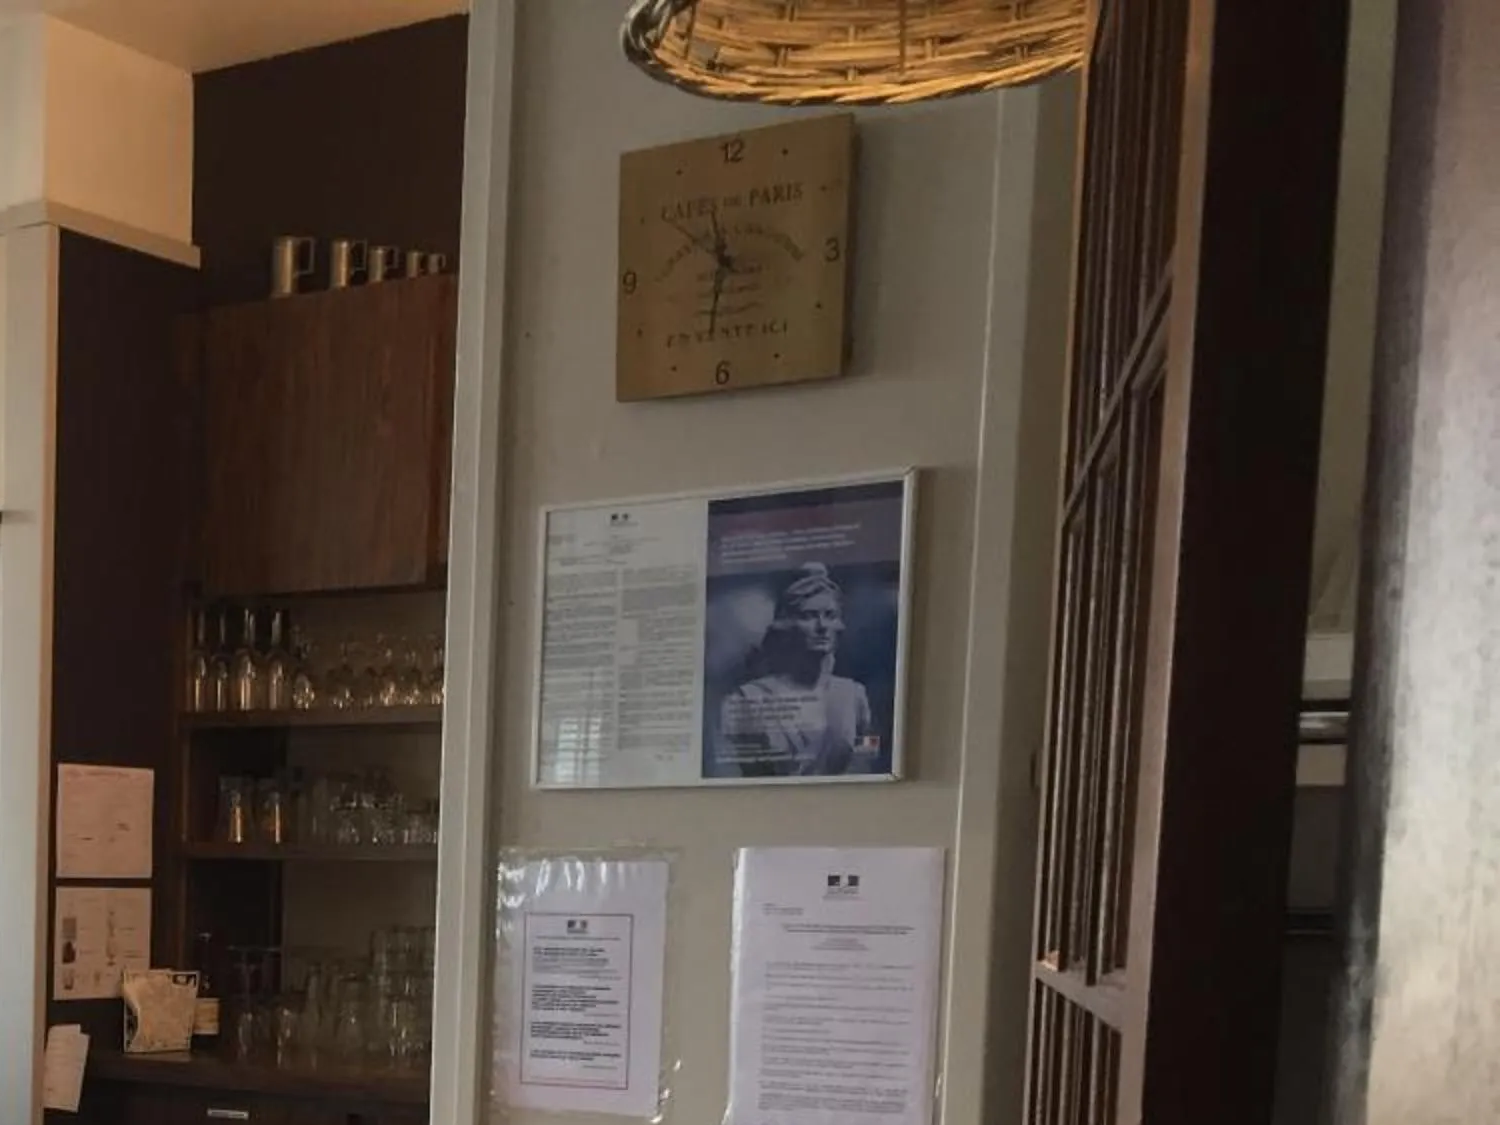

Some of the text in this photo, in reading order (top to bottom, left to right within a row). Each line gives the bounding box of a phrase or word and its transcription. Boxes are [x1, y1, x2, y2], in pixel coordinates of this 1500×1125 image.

[720, 140, 744, 163] 12
[749, 181, 804, 208] PARIS
[825, 237, 840, 263] 3
[622, 270, 638, 295] 9
[715, 359, 732, 385] 6
